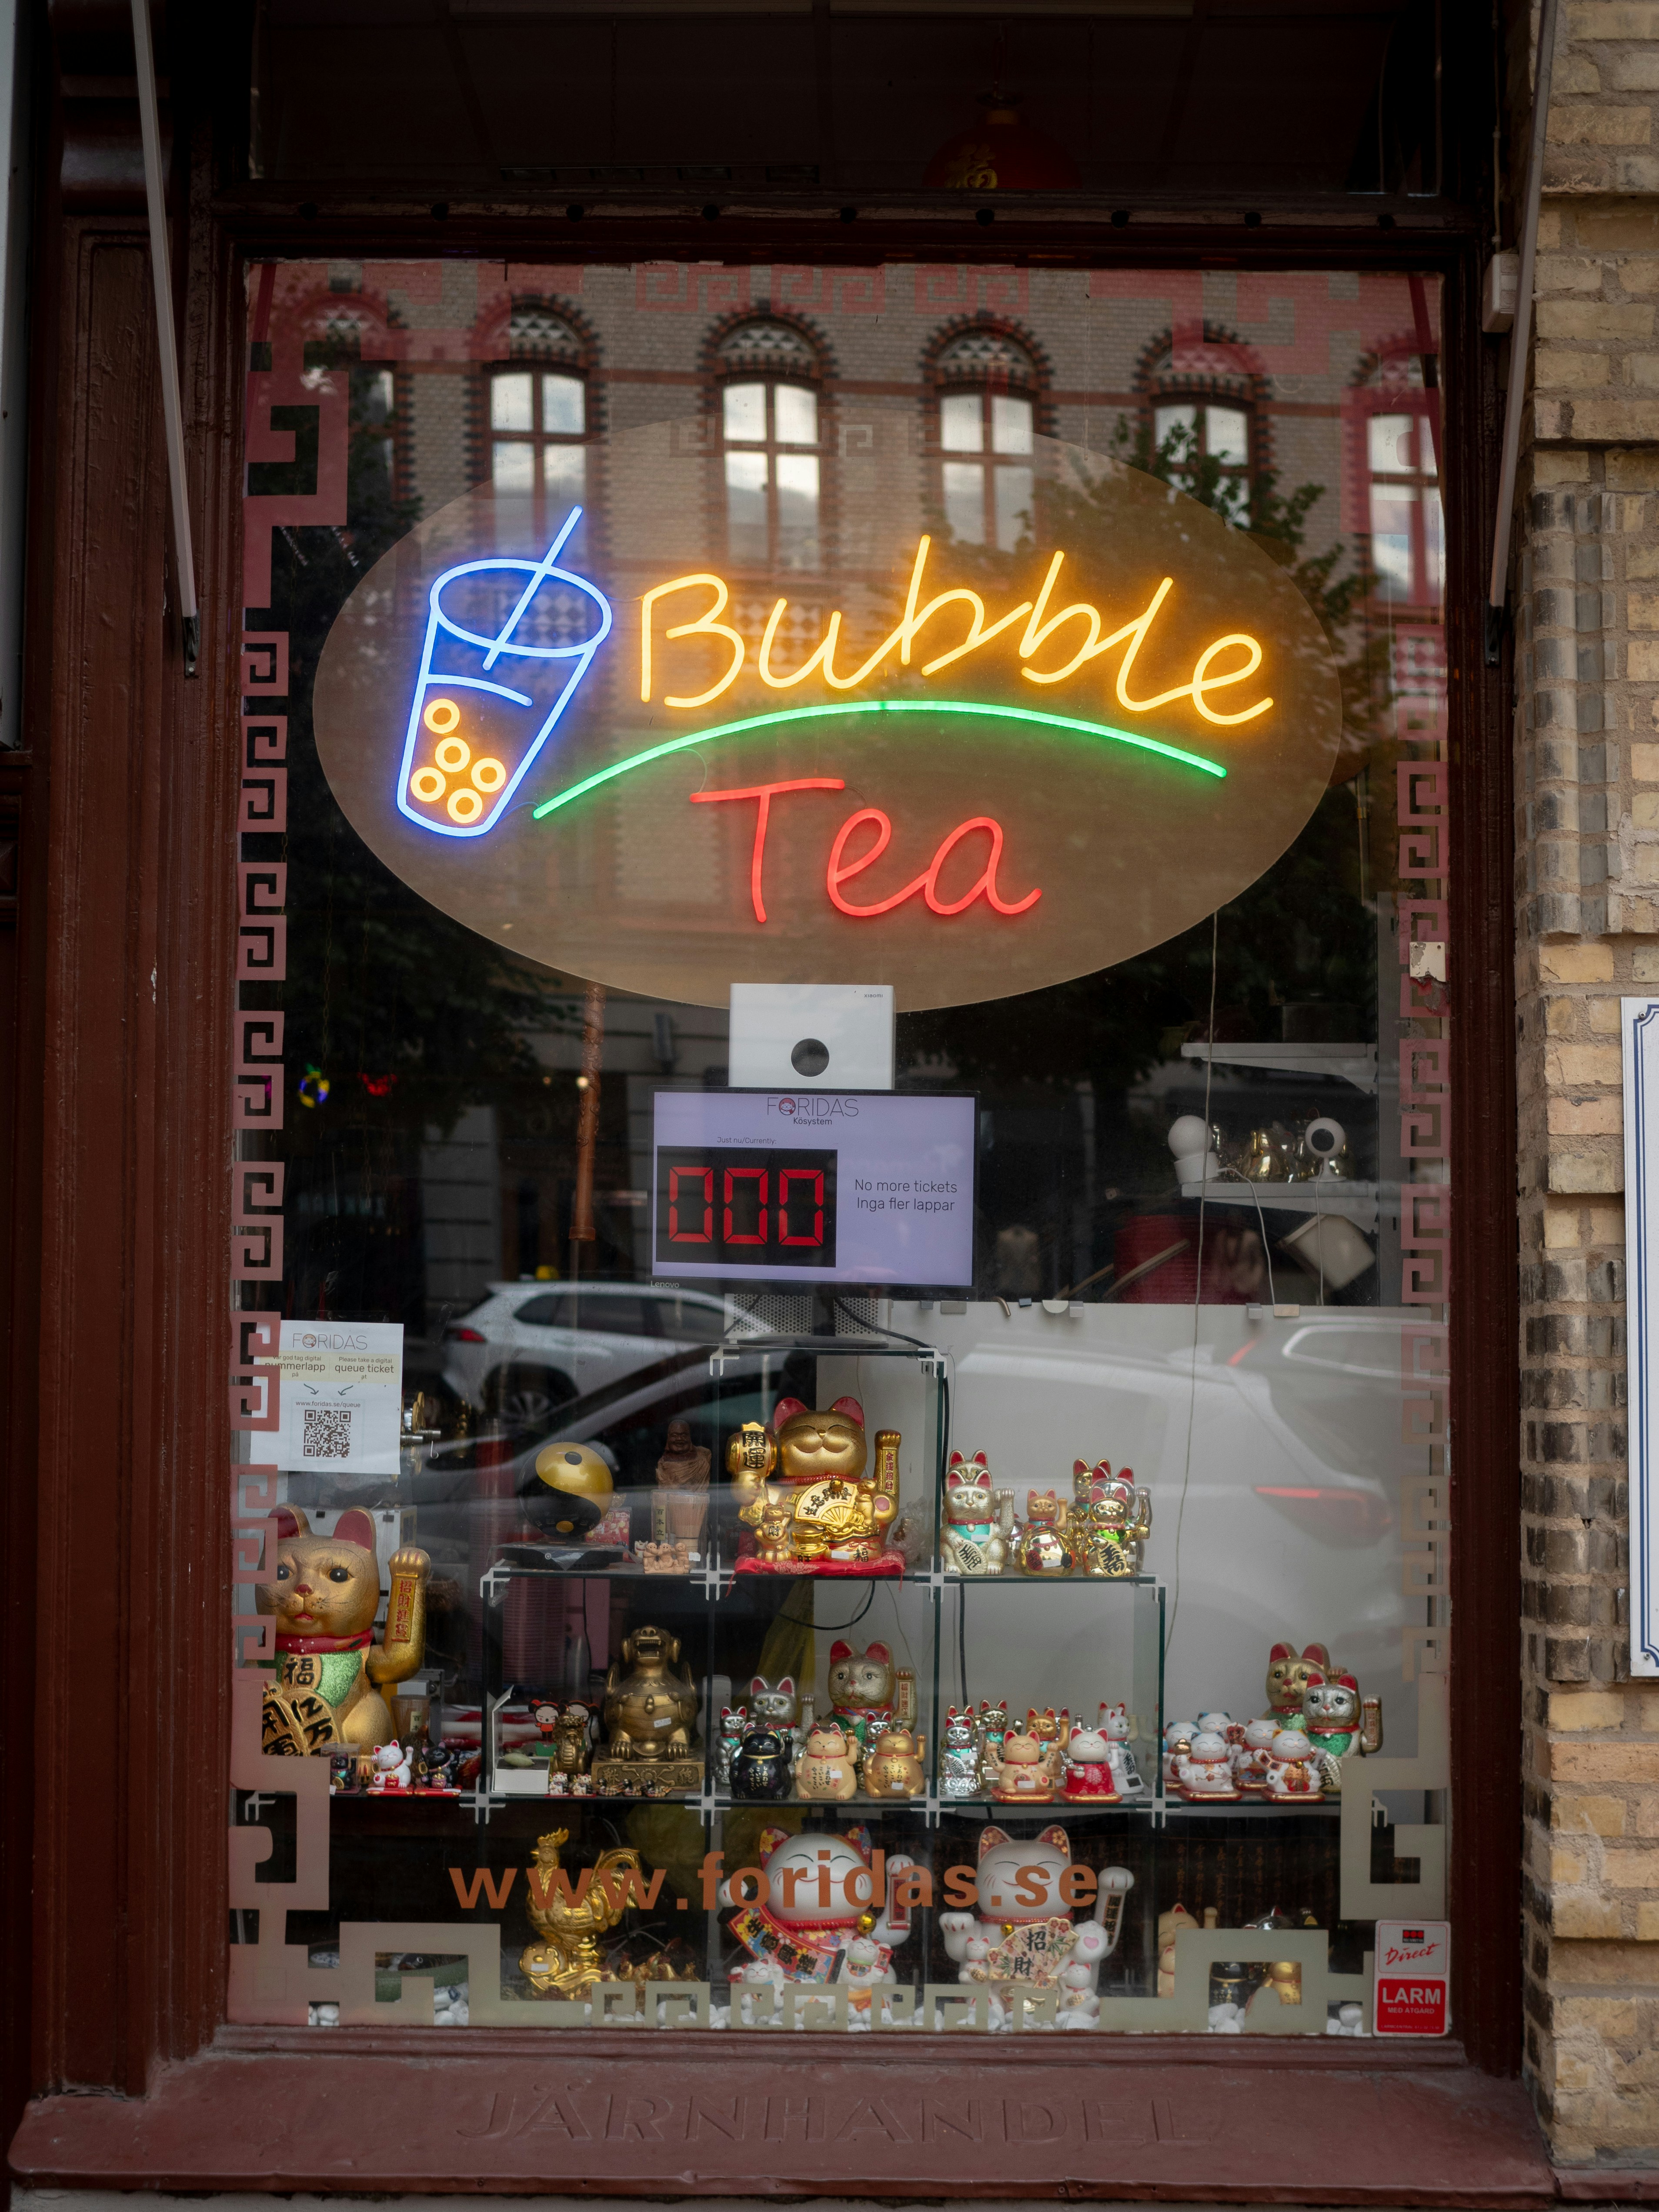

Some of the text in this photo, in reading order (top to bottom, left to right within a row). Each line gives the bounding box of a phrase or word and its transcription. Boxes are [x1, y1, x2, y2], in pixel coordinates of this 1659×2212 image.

[641, 535, 1274, 726] Bubble
[690, 777, 1041, 923] Tea
[767, 1097, 859, 1117] FORIDAS
[793, 1116, 832, 1126] Kösystem
[733, 1136, 777, 1145] nu/Currently:
[855, 1179, 958, 1193] No more tickets
[669, 1167, 824, 1246] 000
[857, 1197, 955, 1213] Inga fler lappar
[293, 1333, 368, 1350] FORIDAS
[367, 1364, 394, 1373] ticket
[284, 1657, 314, 1684] 福
[450, 1848, 1100, 1910] www.foridas.se
[1385, 1943, 1441, 1965] Direct
[1382, 1987, 1440, 2005] LARM
[456, 2083, 1212, 2145] JÄRNHANDEL
